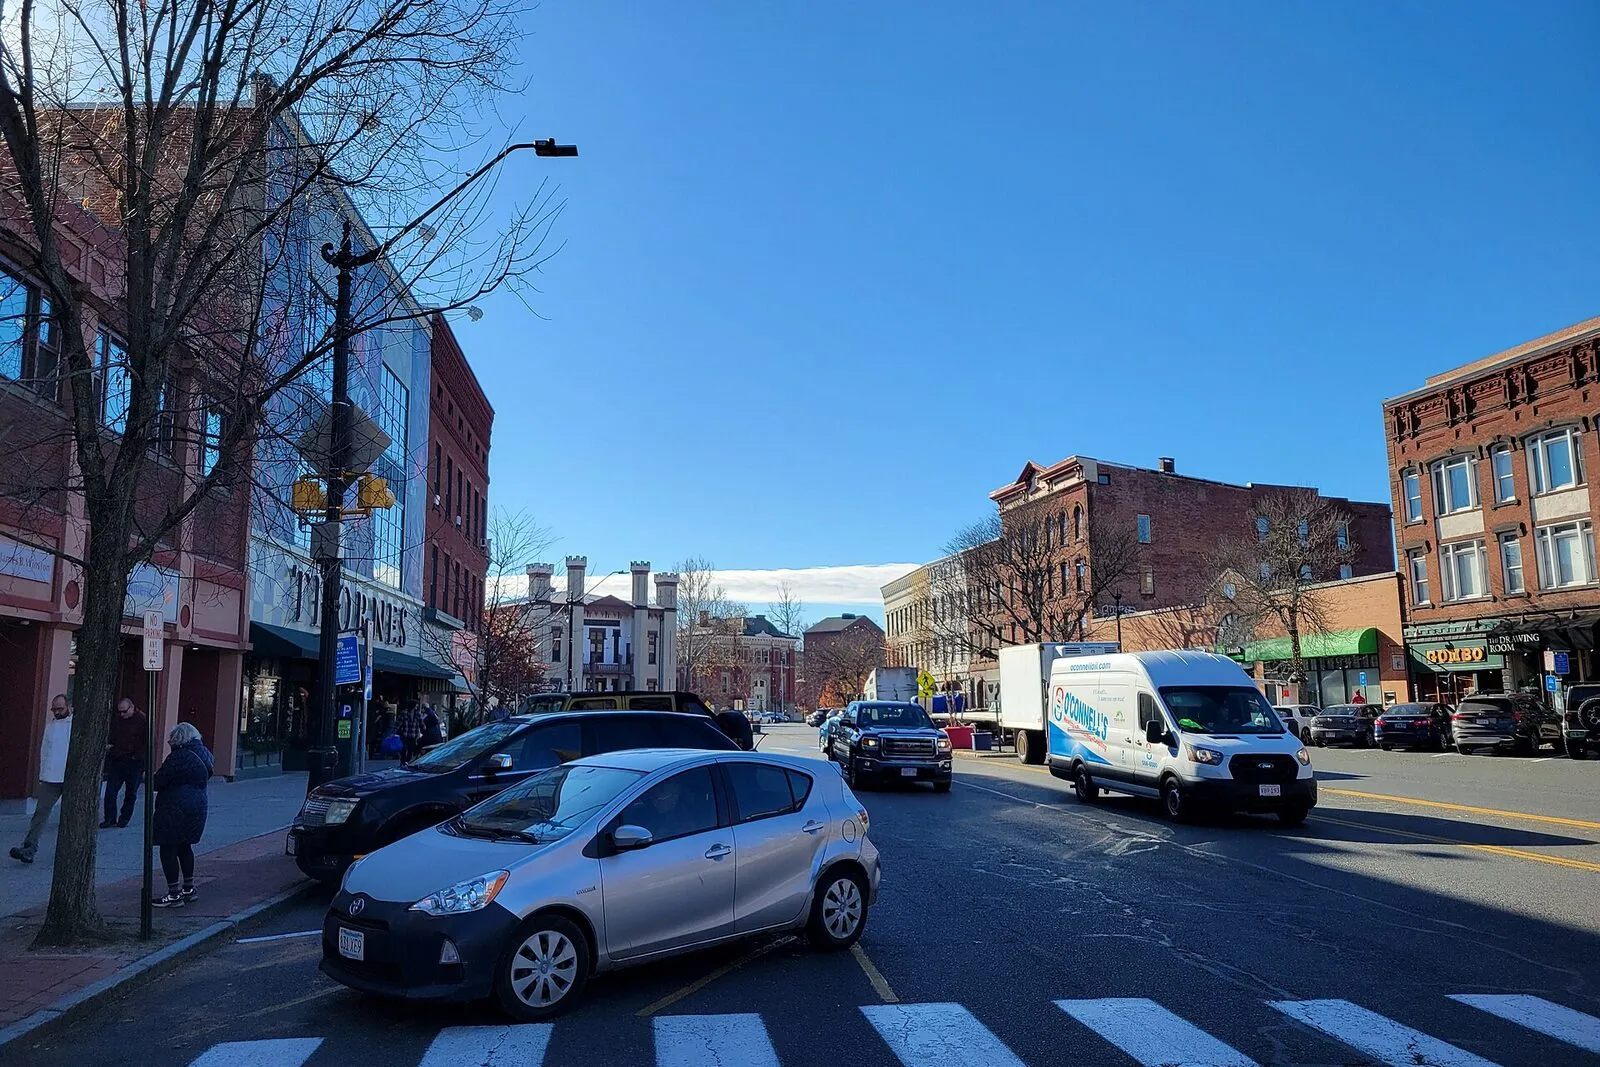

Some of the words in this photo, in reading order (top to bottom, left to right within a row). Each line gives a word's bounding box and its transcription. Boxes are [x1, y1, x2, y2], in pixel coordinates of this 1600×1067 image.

[149, 615, 158, 626] NO
[1500, 633, 1540, 644] DRAWING
[1489, 643, 1515, 652] ROOM
[1426, 646, 1484, 664] GUMBO
[343, 704, 352, 717] P
[1064, 692, 1108, 741] O'CONNELL'S
